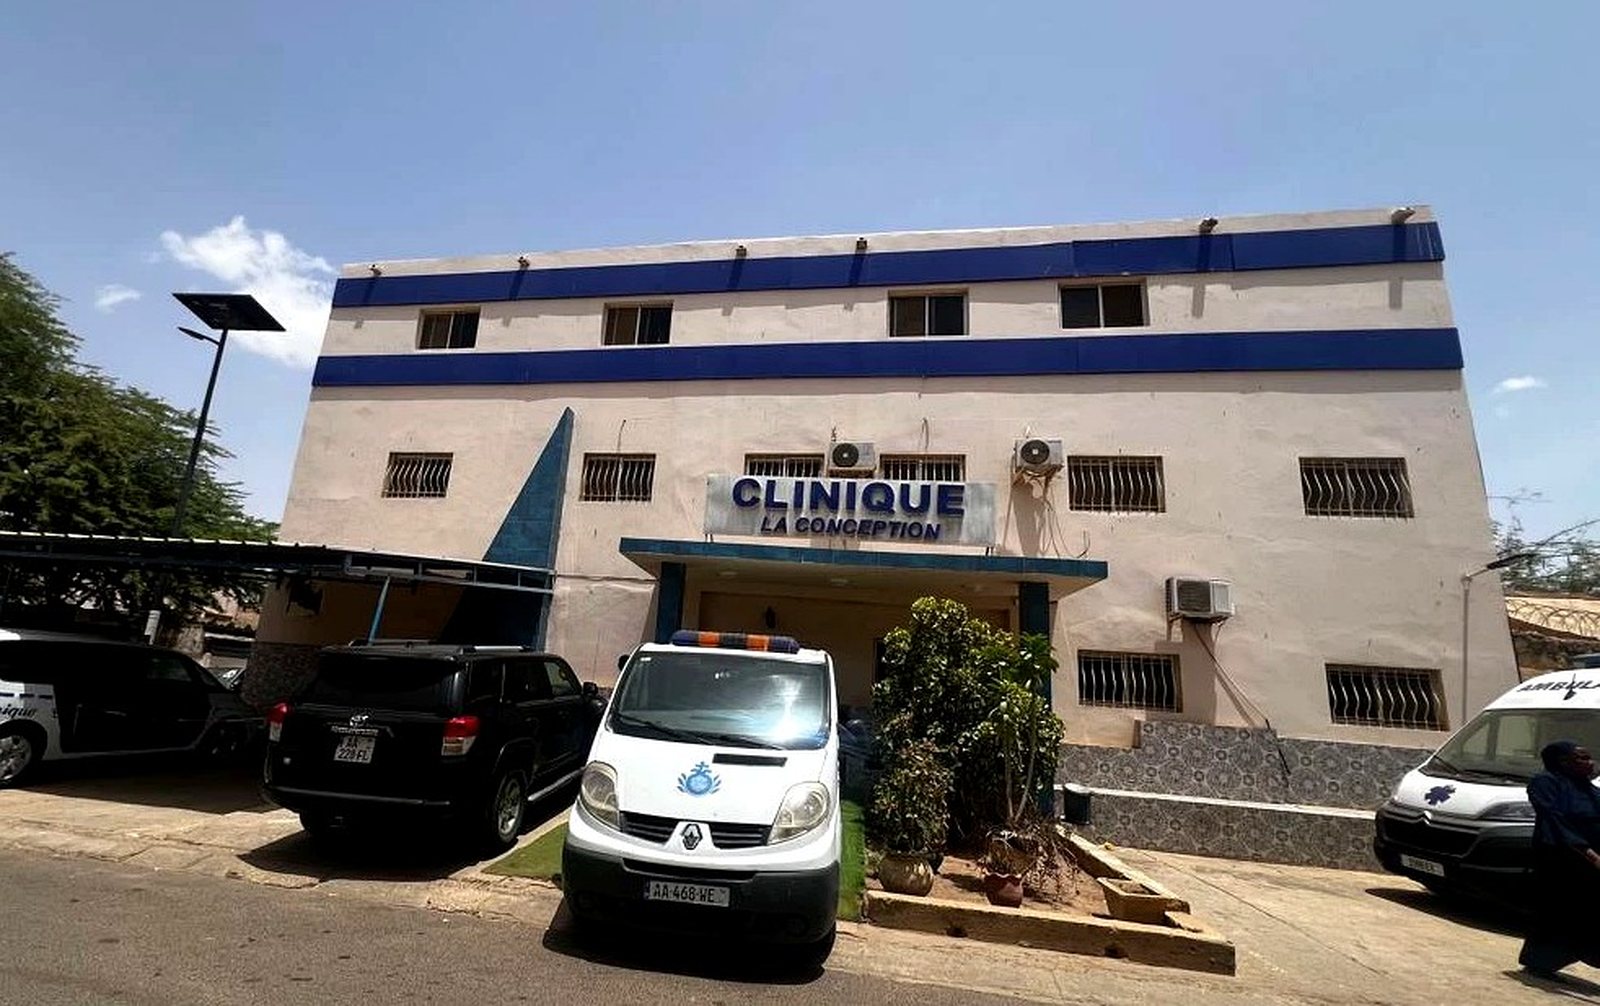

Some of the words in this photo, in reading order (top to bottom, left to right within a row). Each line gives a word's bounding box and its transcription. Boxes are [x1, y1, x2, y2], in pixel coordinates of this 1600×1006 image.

[732, 478, 966, 515] CLINIQUE
[760, 516, 788, 534] LA
[795, 516, 941, 540] CONCEPTION
